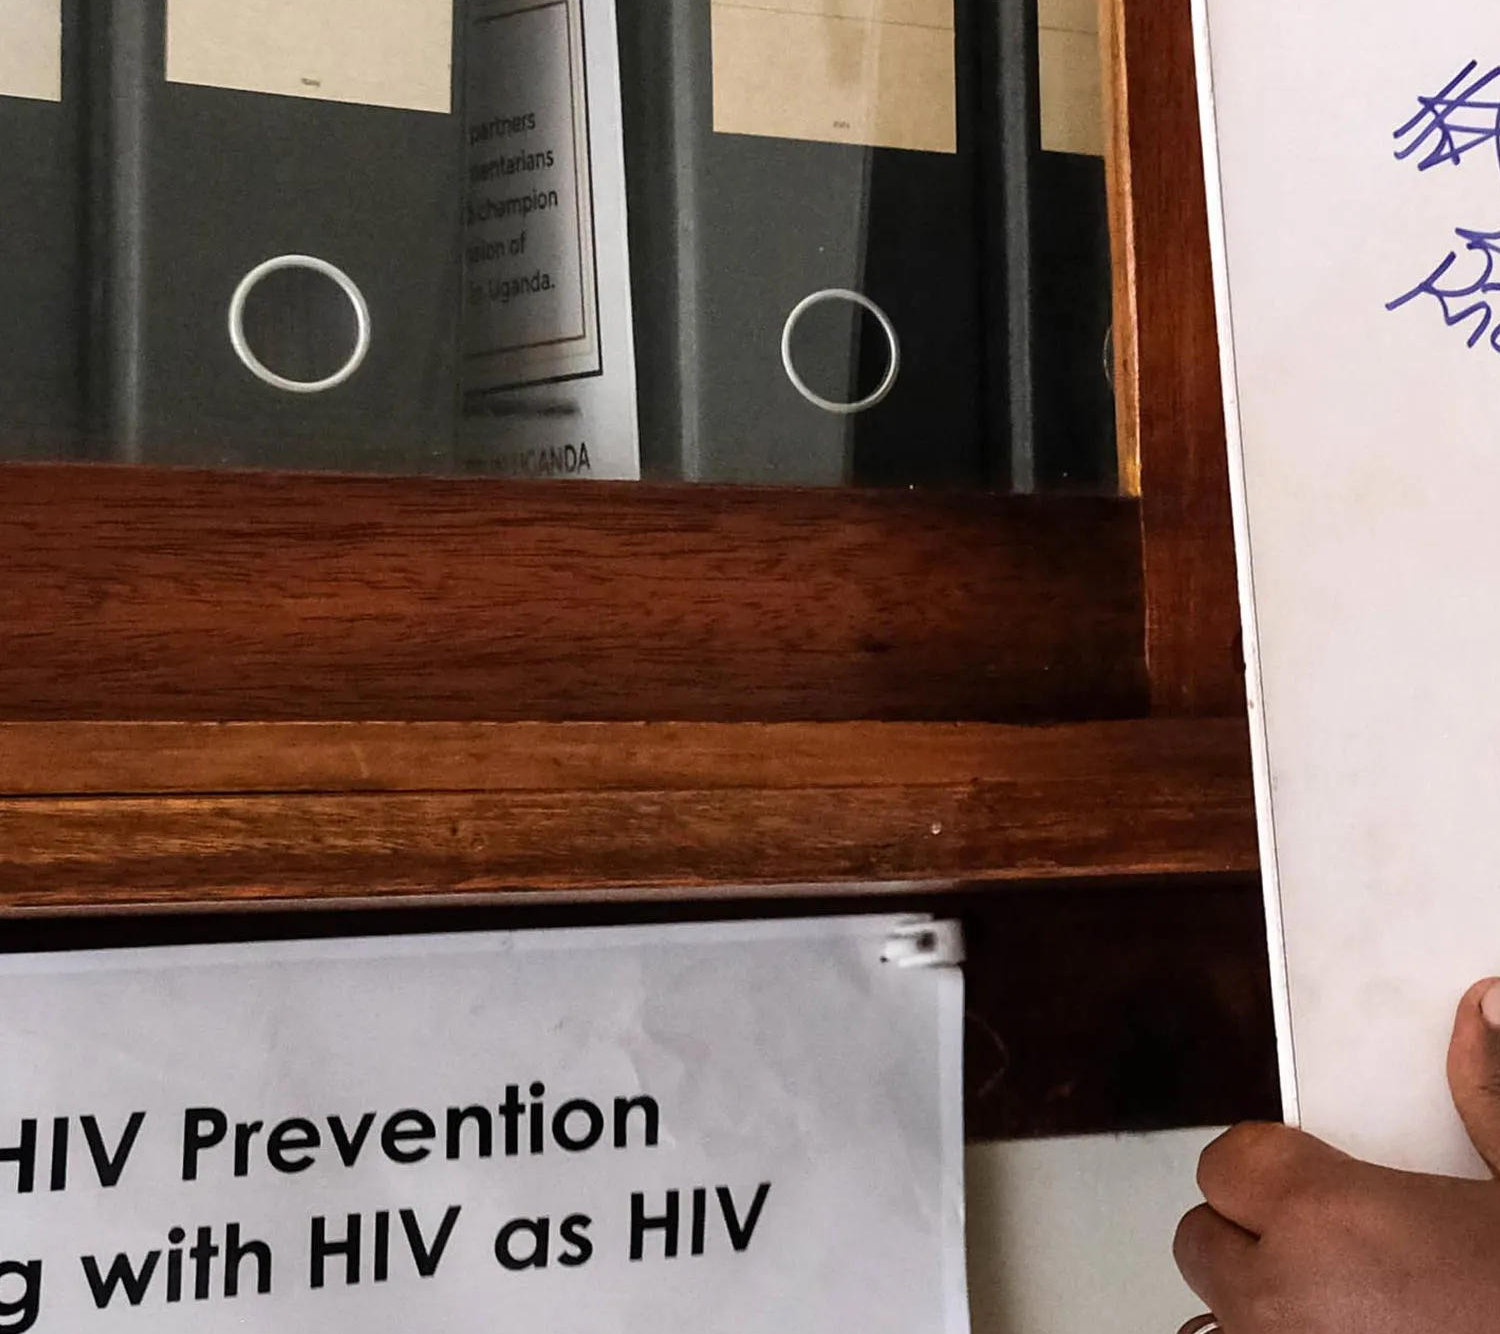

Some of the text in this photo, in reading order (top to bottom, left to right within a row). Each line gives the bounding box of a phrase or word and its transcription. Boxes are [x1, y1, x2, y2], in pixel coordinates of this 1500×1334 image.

[0, 1082, 661, 1194] HIV Prevention
[80, 1223, 273, 1309] with
[309, 1205, 462, 1290] HIV
[494, 1210, 595, 1270] as
[628, 1183, 772, 1263] HIV
